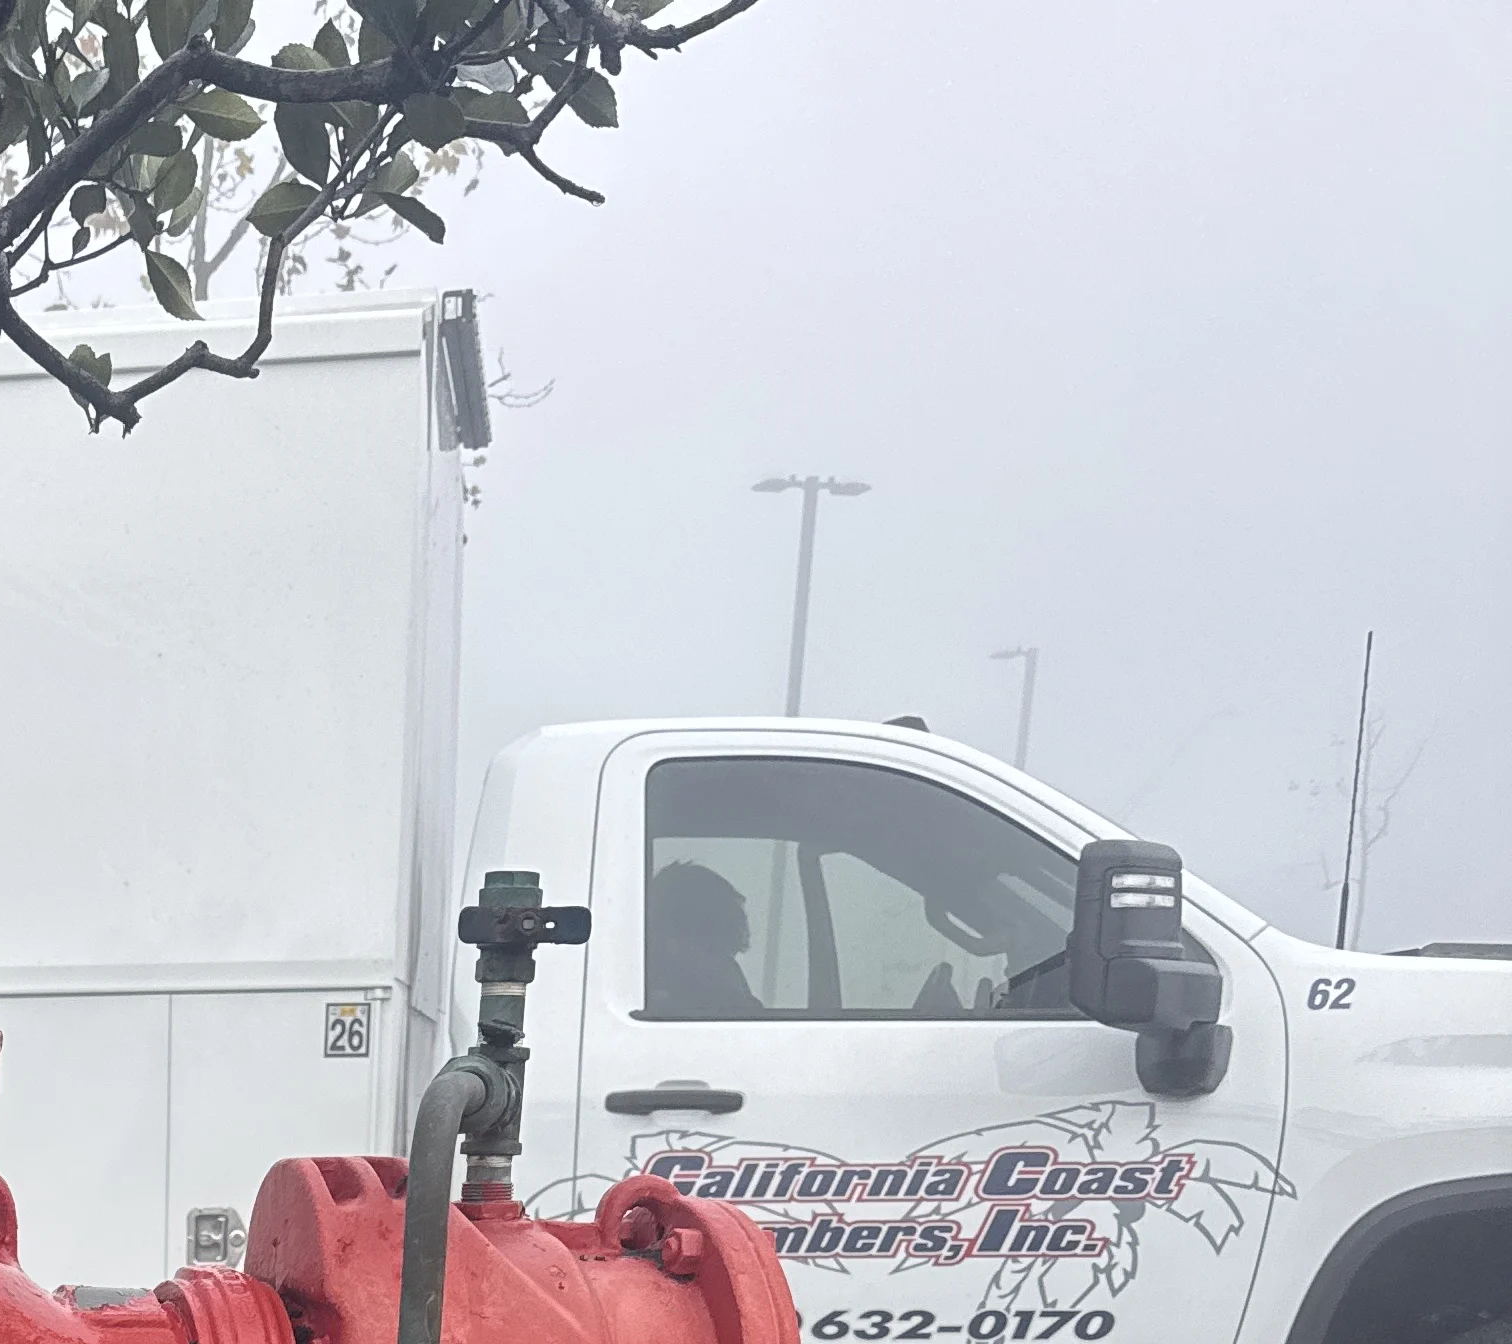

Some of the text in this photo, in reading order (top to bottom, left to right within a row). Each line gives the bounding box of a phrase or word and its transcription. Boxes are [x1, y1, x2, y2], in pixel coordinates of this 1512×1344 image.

[1307, 978, 1356, 1010] 62
[329, 1018, 364, 1052] 26
[642, 1149, 1189, 1200] California Coast
[761, 1206, 1100, 1262] mbers, Inc.
[811, 1310, 1115, 1341] 632-0170
